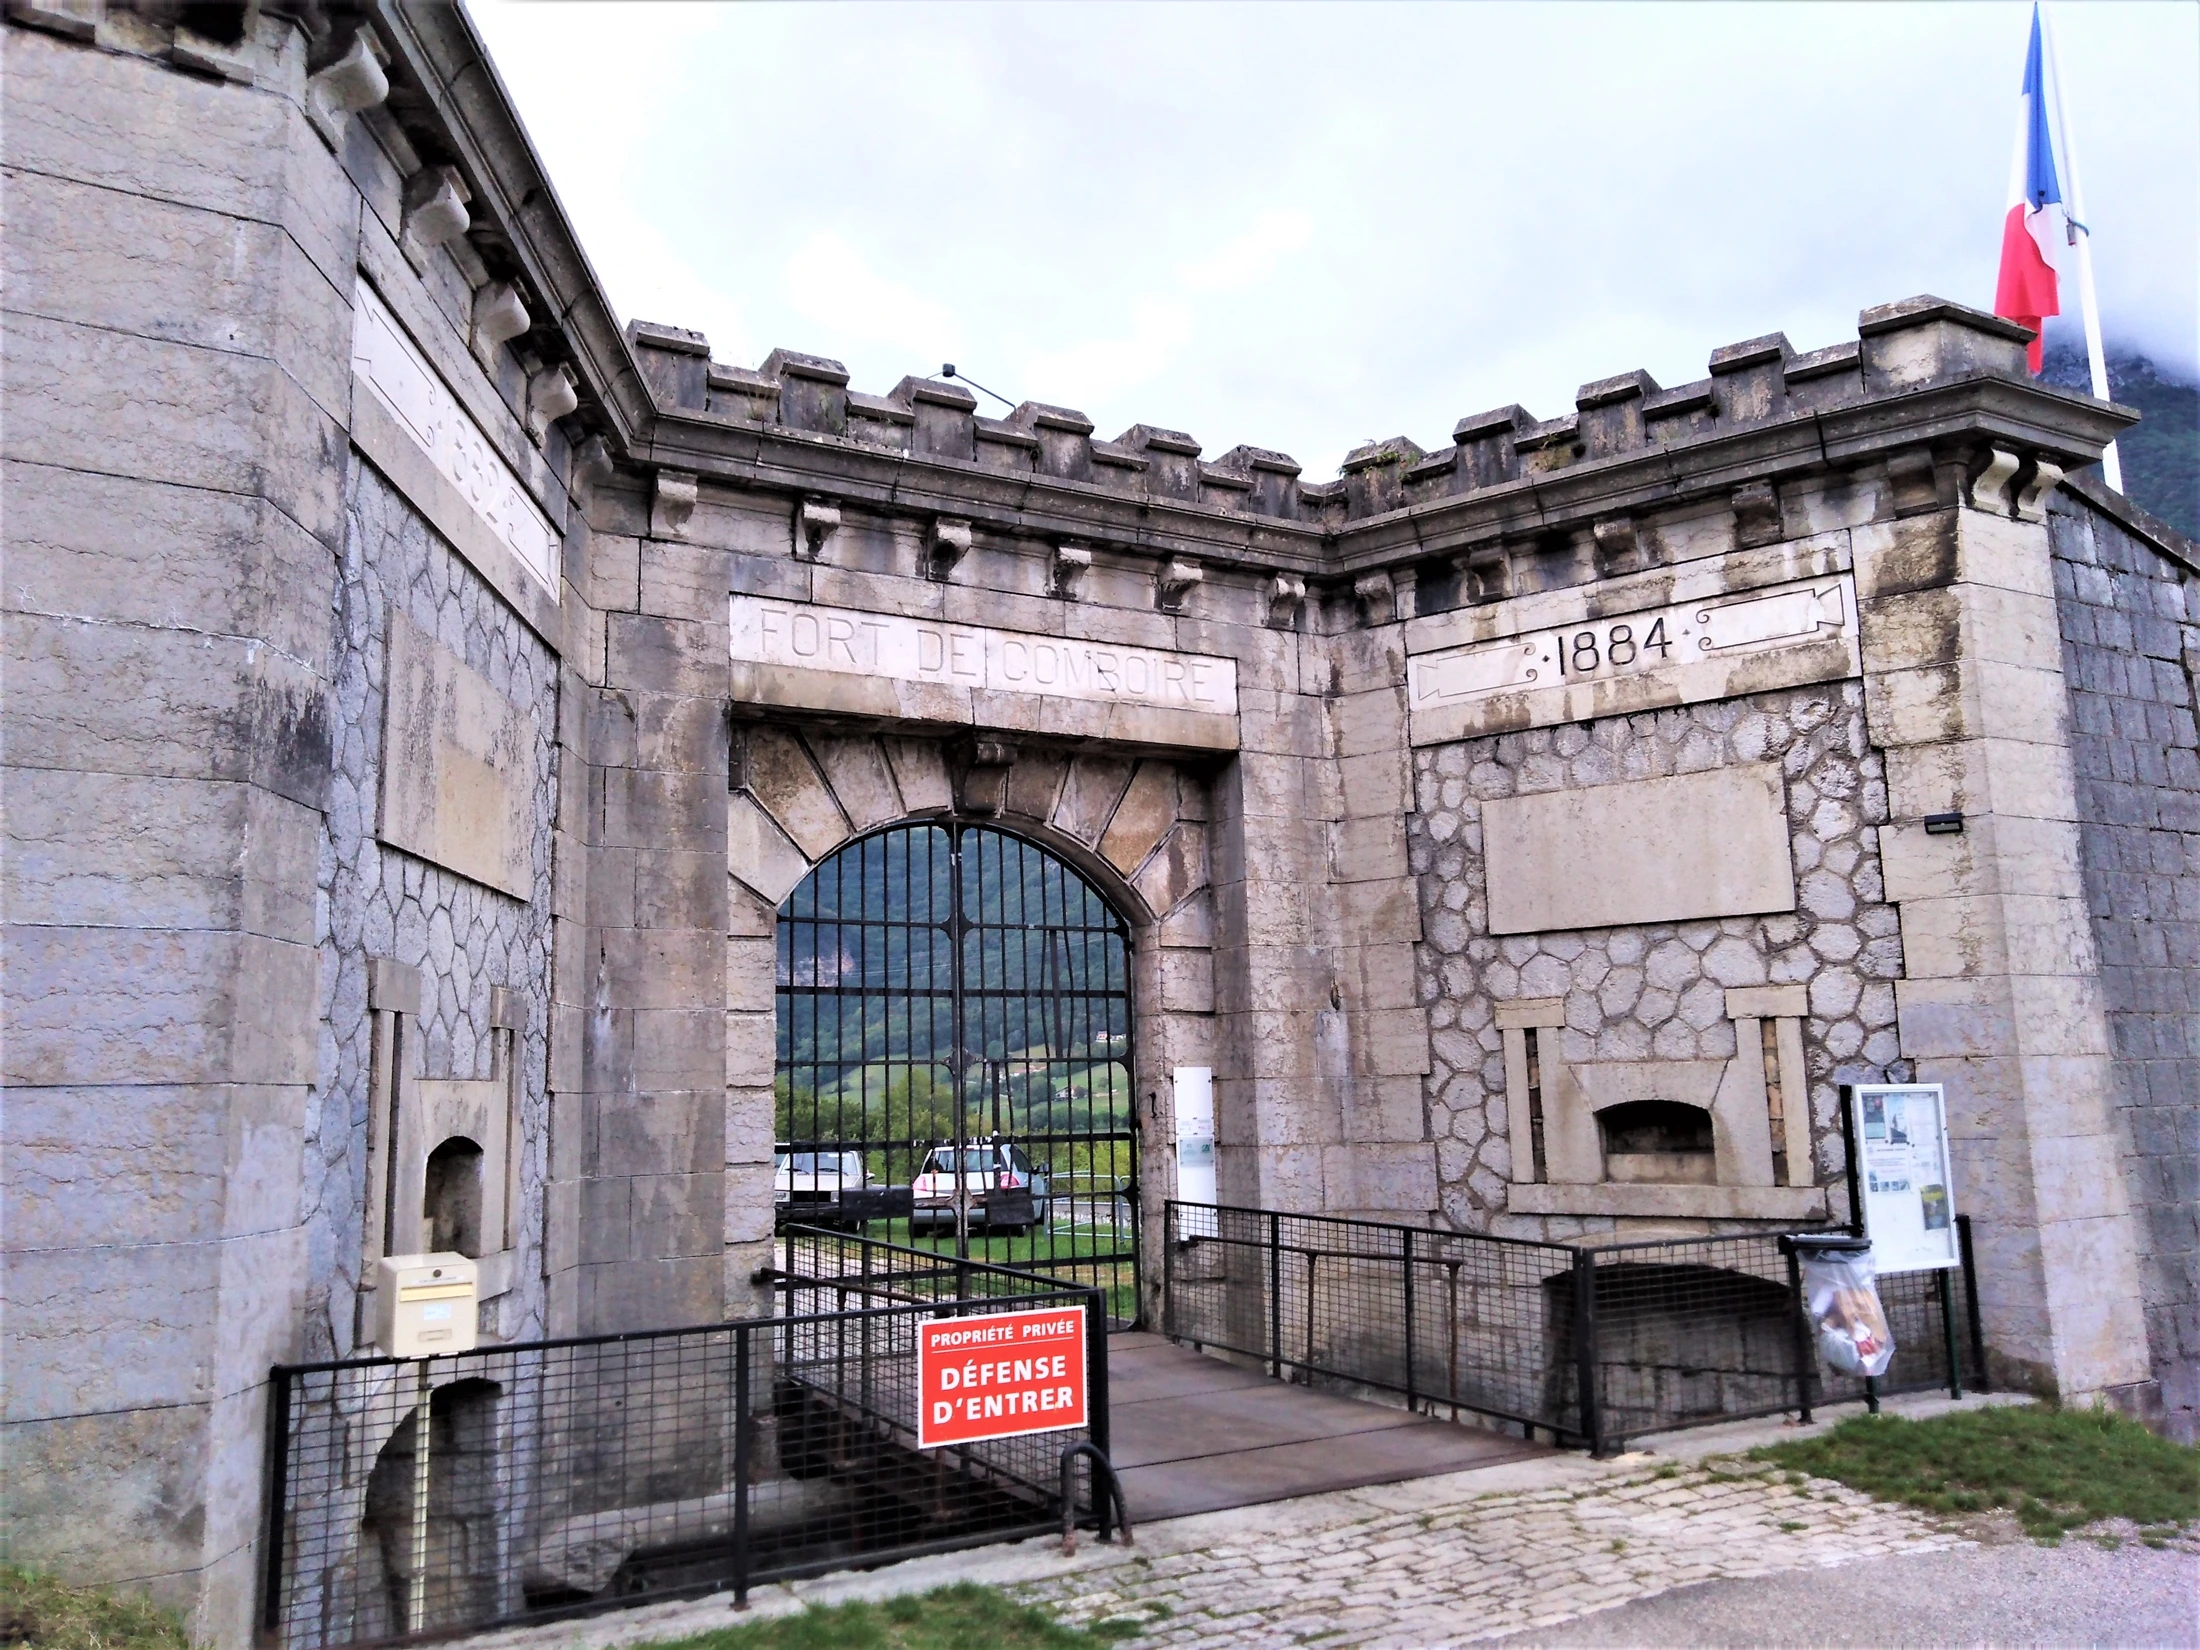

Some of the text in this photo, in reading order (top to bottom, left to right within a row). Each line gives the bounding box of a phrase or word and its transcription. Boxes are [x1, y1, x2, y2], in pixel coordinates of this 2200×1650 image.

[761, 607, 1215, 702] FORT DE COMBOIRE
[1558, 617, 1673, 676] 1884
[931, 1319, 1074, 1347] PROPRIÉTÉ PRIVÉE
[941, 1355, 1066, 1390] DÉFENSE
[933, 1386, 1073, 1424] D'ENTRER
